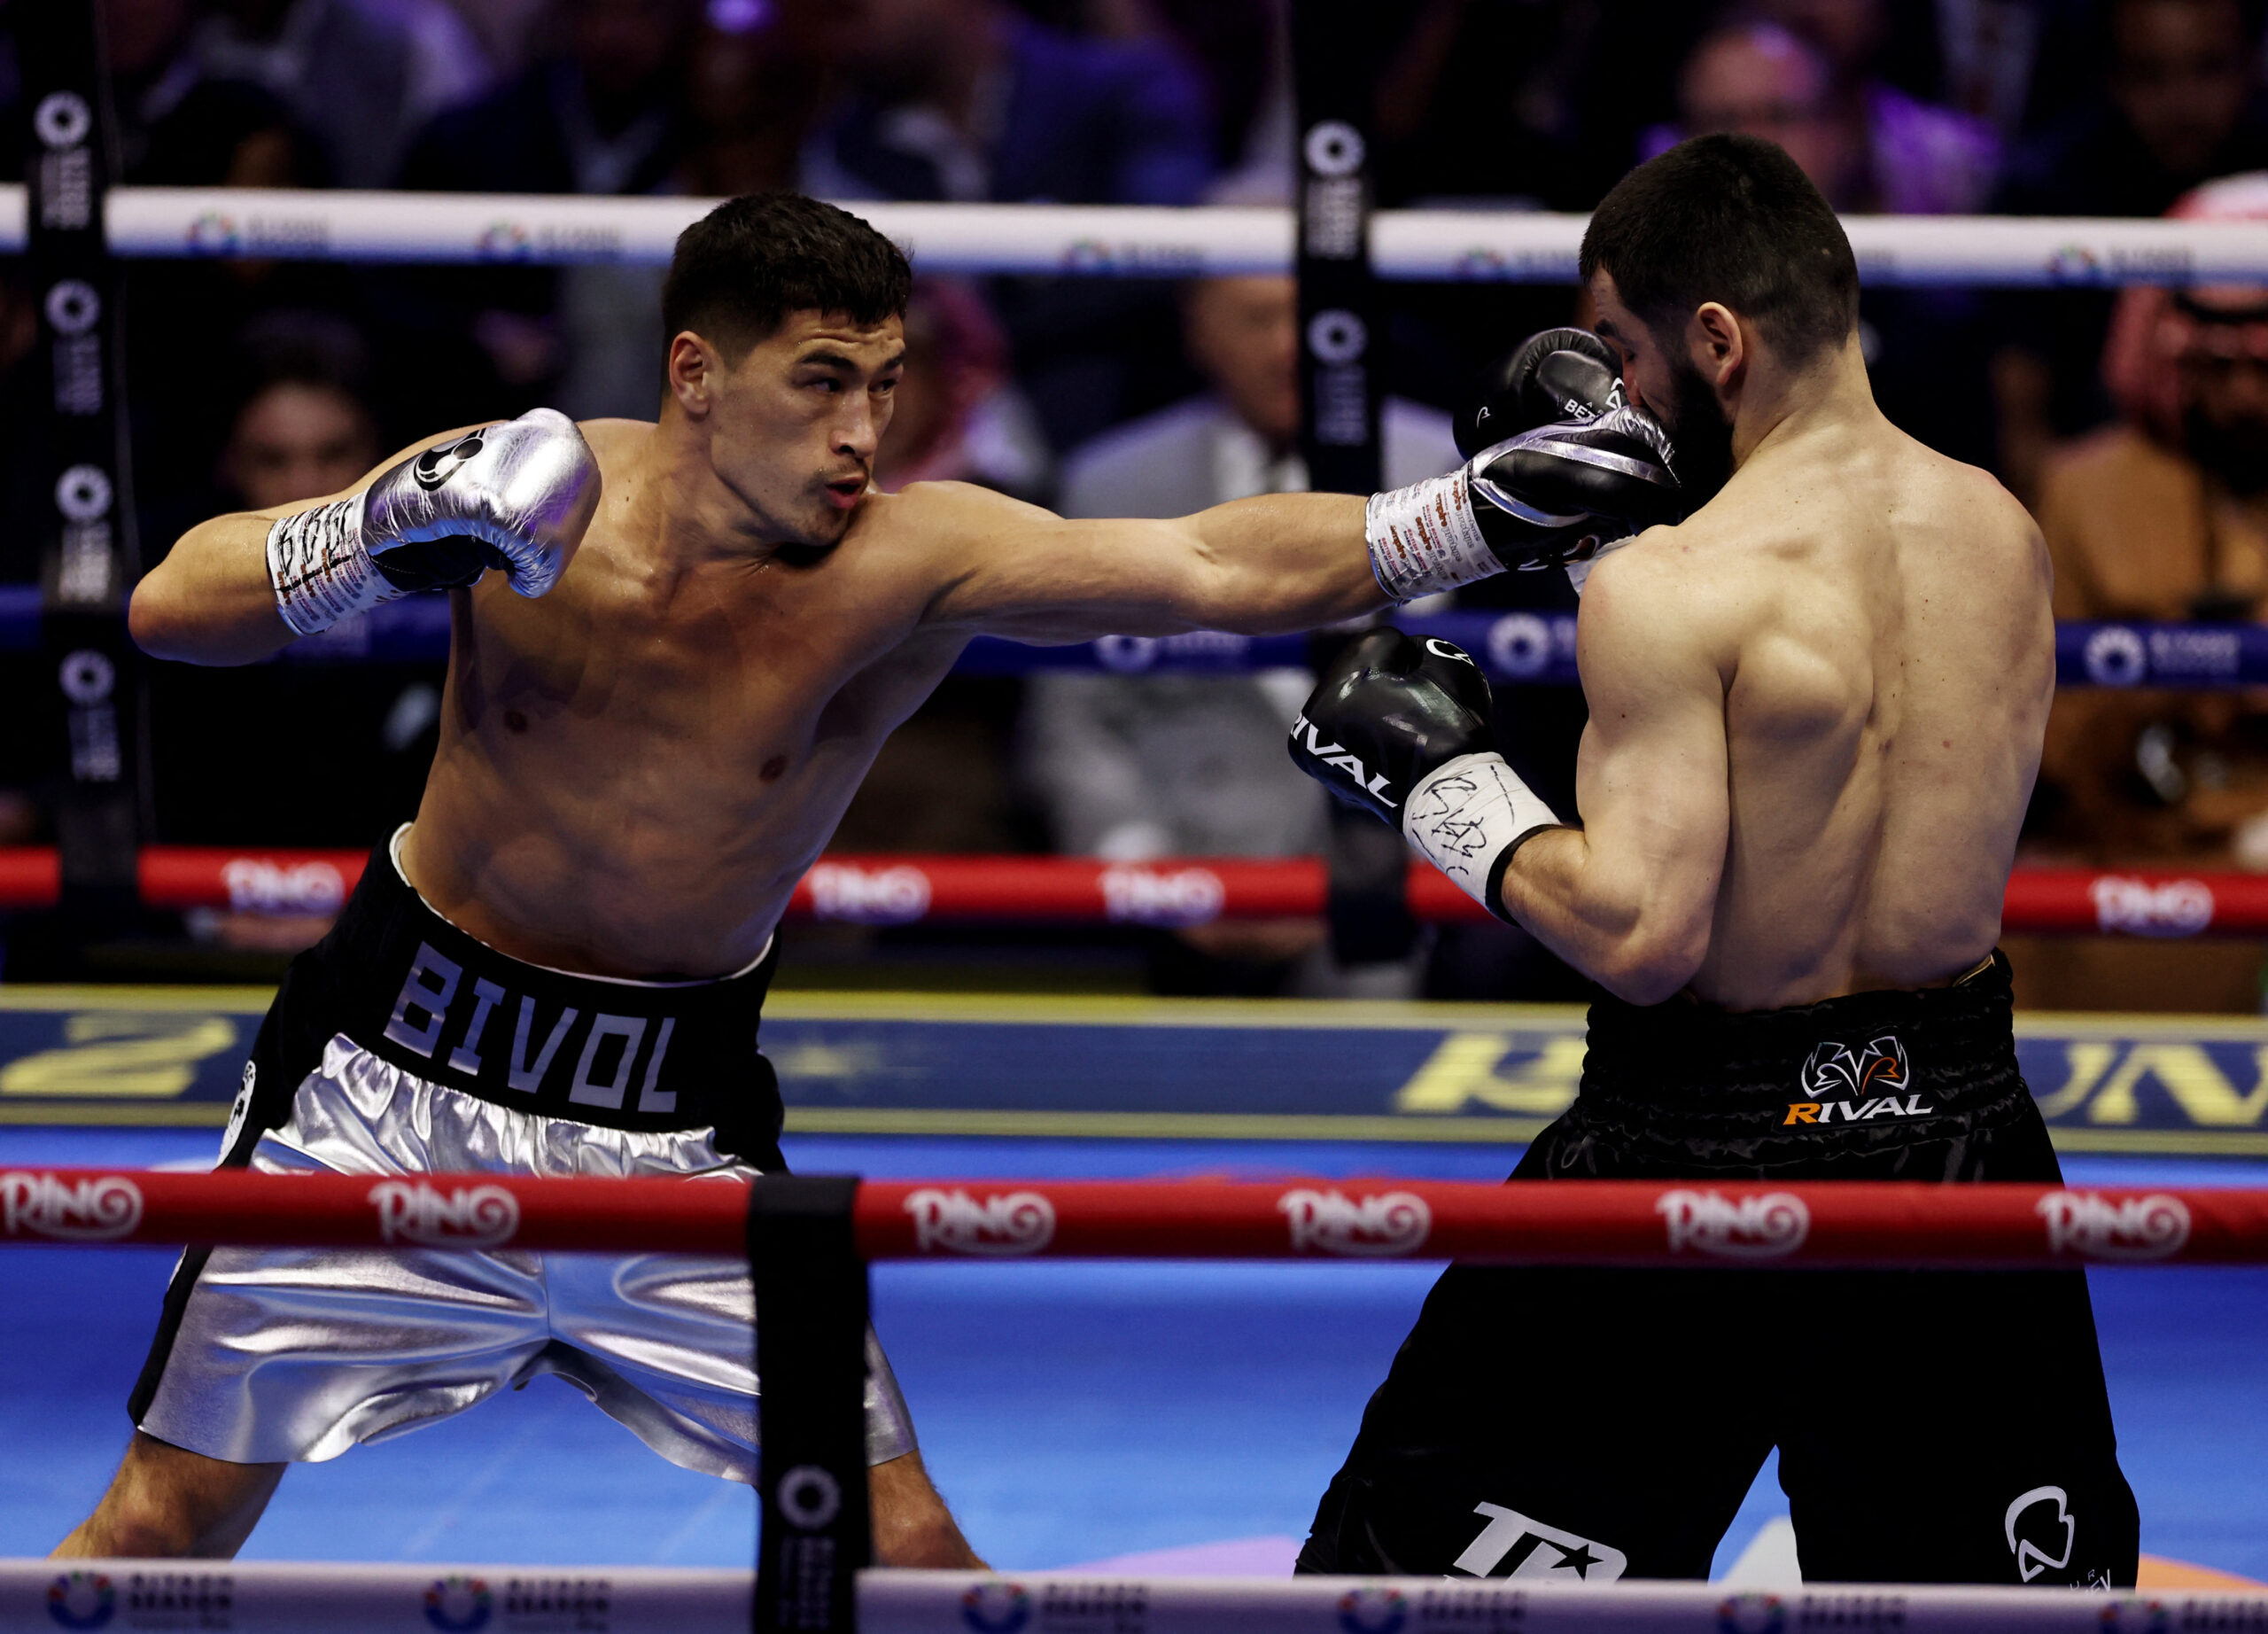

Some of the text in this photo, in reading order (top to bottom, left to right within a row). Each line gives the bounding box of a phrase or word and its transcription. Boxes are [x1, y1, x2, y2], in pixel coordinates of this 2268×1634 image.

[383, 941, 679, 1114] BIVOL
[1783, 1093, 1935, 1126] RIVAL
[0, 1171, 145, 1241] RING
[367, 1180, 521, 1249] RING
[904, 1187, 1059, 1256] RING
[1276, 1188, 1432, 1255] RING
[1655, 1189, 1813, 1258] RING
[2035, 1191, 2193, 1261] RING
